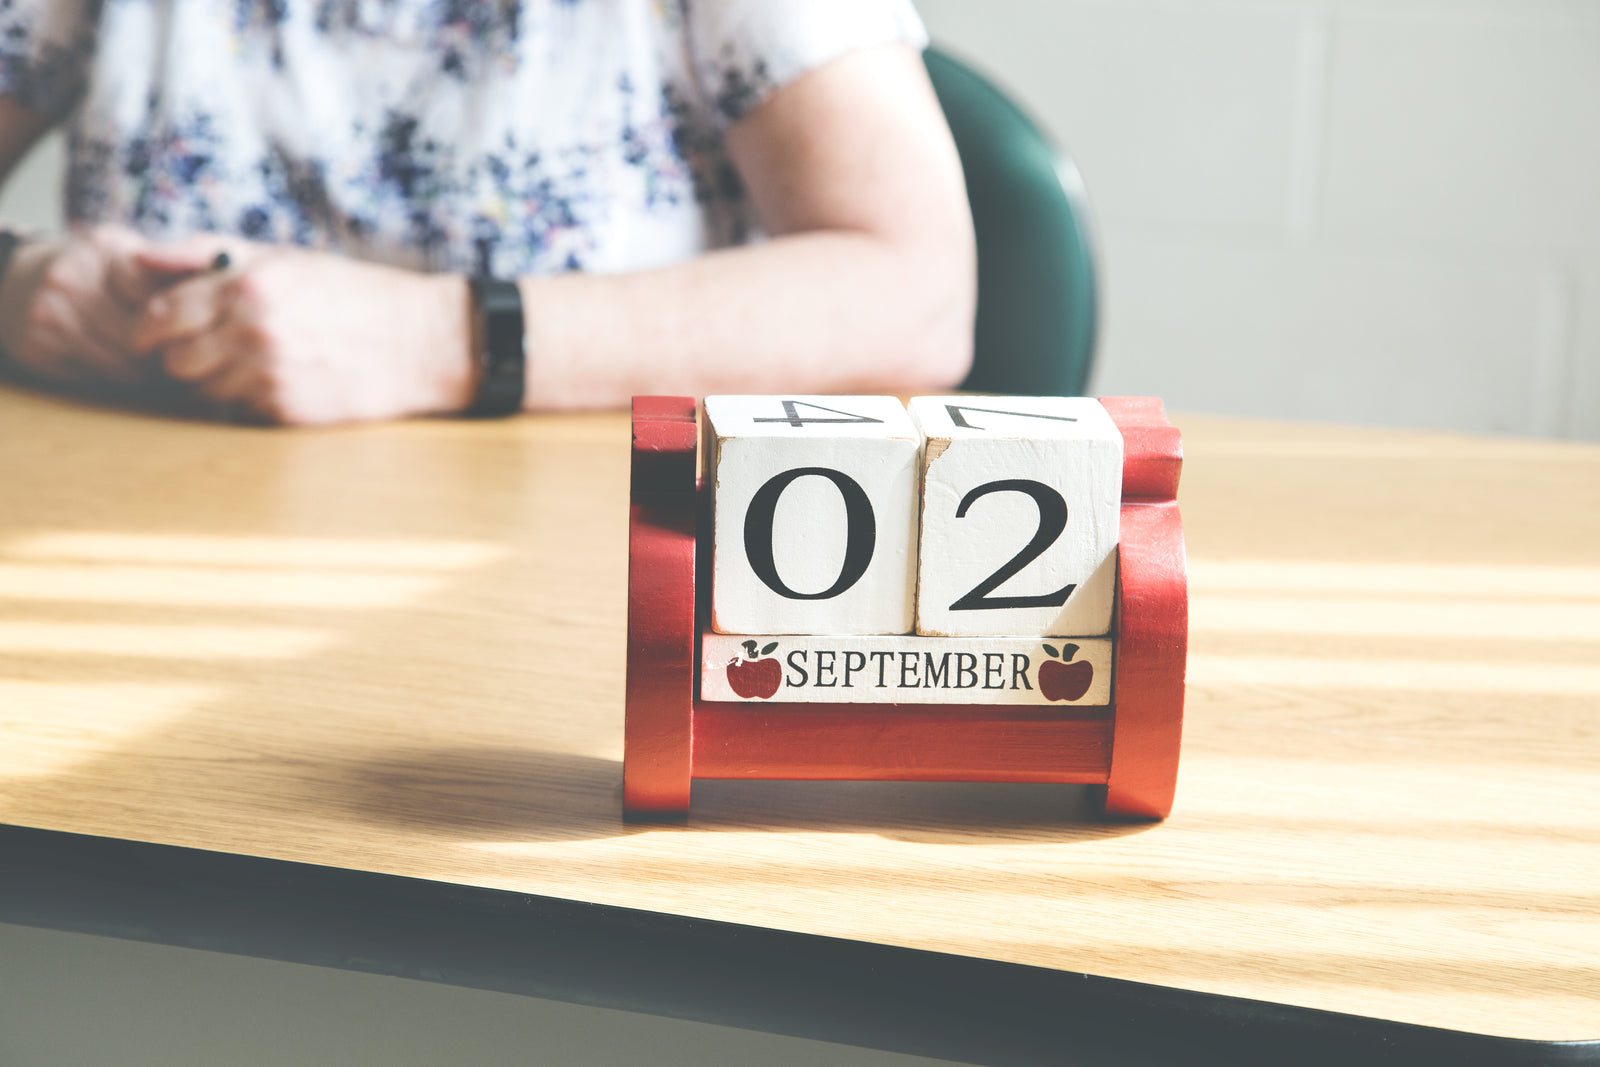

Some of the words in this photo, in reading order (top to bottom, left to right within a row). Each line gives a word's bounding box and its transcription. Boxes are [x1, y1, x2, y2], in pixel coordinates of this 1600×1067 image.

[753, 401, 883, 427] 4
[945, 405, 1076, 429] 7
[787, 650, 1033, 690] SEPTEMBER
